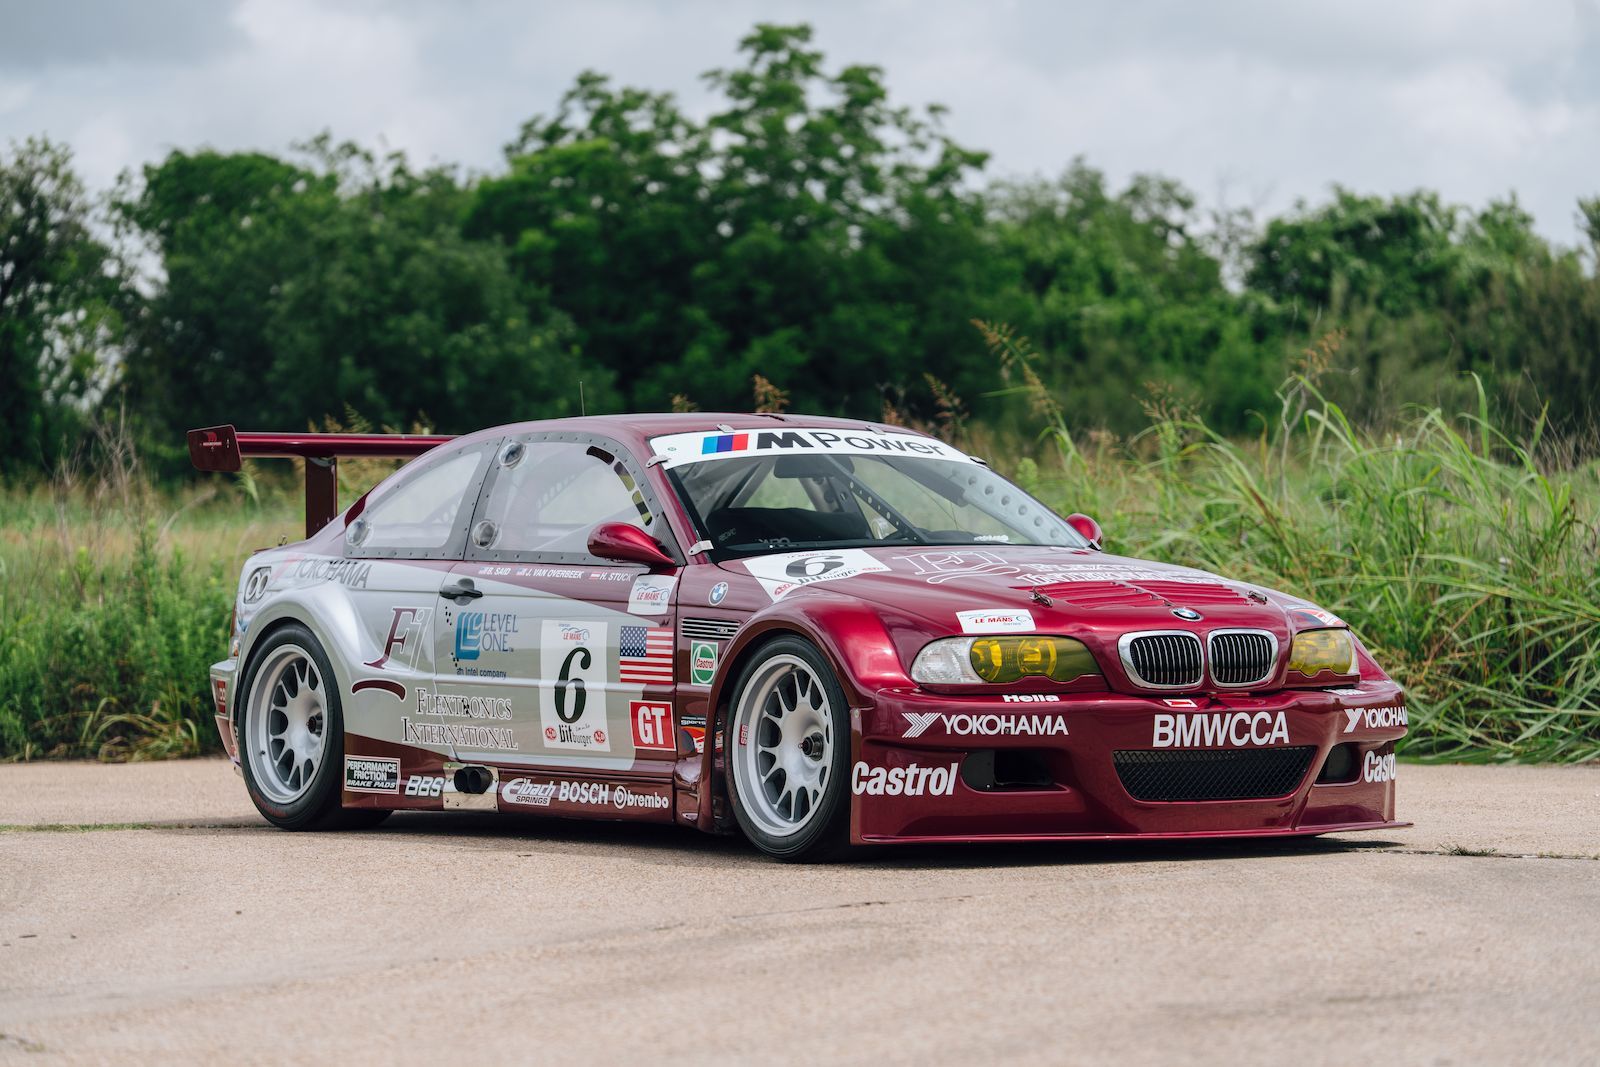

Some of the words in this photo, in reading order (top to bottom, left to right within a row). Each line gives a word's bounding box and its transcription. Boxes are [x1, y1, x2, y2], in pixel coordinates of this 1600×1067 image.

[293, 559, 372, 588] YOKOHAMA
[494, 568, 511, 576] SAID
[533, 568, 547, 578] VAN
[547, 568, 585, 580] OVERBEEK
[785, 555, 845, 577] 6
[608, 573, 633, 582] STUCK
[483, 613, 519, 632] LEVEL
[481, 633, 509, 652] ONE
[465, 667, 478, 676] Intel
[479, 669, 507, 678] company
[696, 658, 714, 669] Castrol
[554, 646, 592, 724] 6
[1002, 694, 1060, 703] Hella
[637, 705, 667, 745] GT
[941, 714, 1069, 736] YOKOHAMA
[1363, 706, 1409, 729] YOKOHAM
[401, 716, 519, 750] INTERNATIONAL
[740, 725, 749, 745] BBS
[1152, 711, 1290, 748] BMWCCA
[347, 760, 397, 772] PERFORMANCE
[353, 771, 387, 781] FRICTION
[1363, 750, 1396, 783] Castro
[346, 779, 373, 787] BRAKE
[373, 781, 396, 789] PADS
[404, 775, 446, 797] BBS
[851, 761, 959, 796] Castrol
[501, 777, 555, 803] Eibach
[515, 795, 548, 805] SPRINGS
[558, 781, 609, 805] BOSCH
[626, 788, 669, 809] brembo
